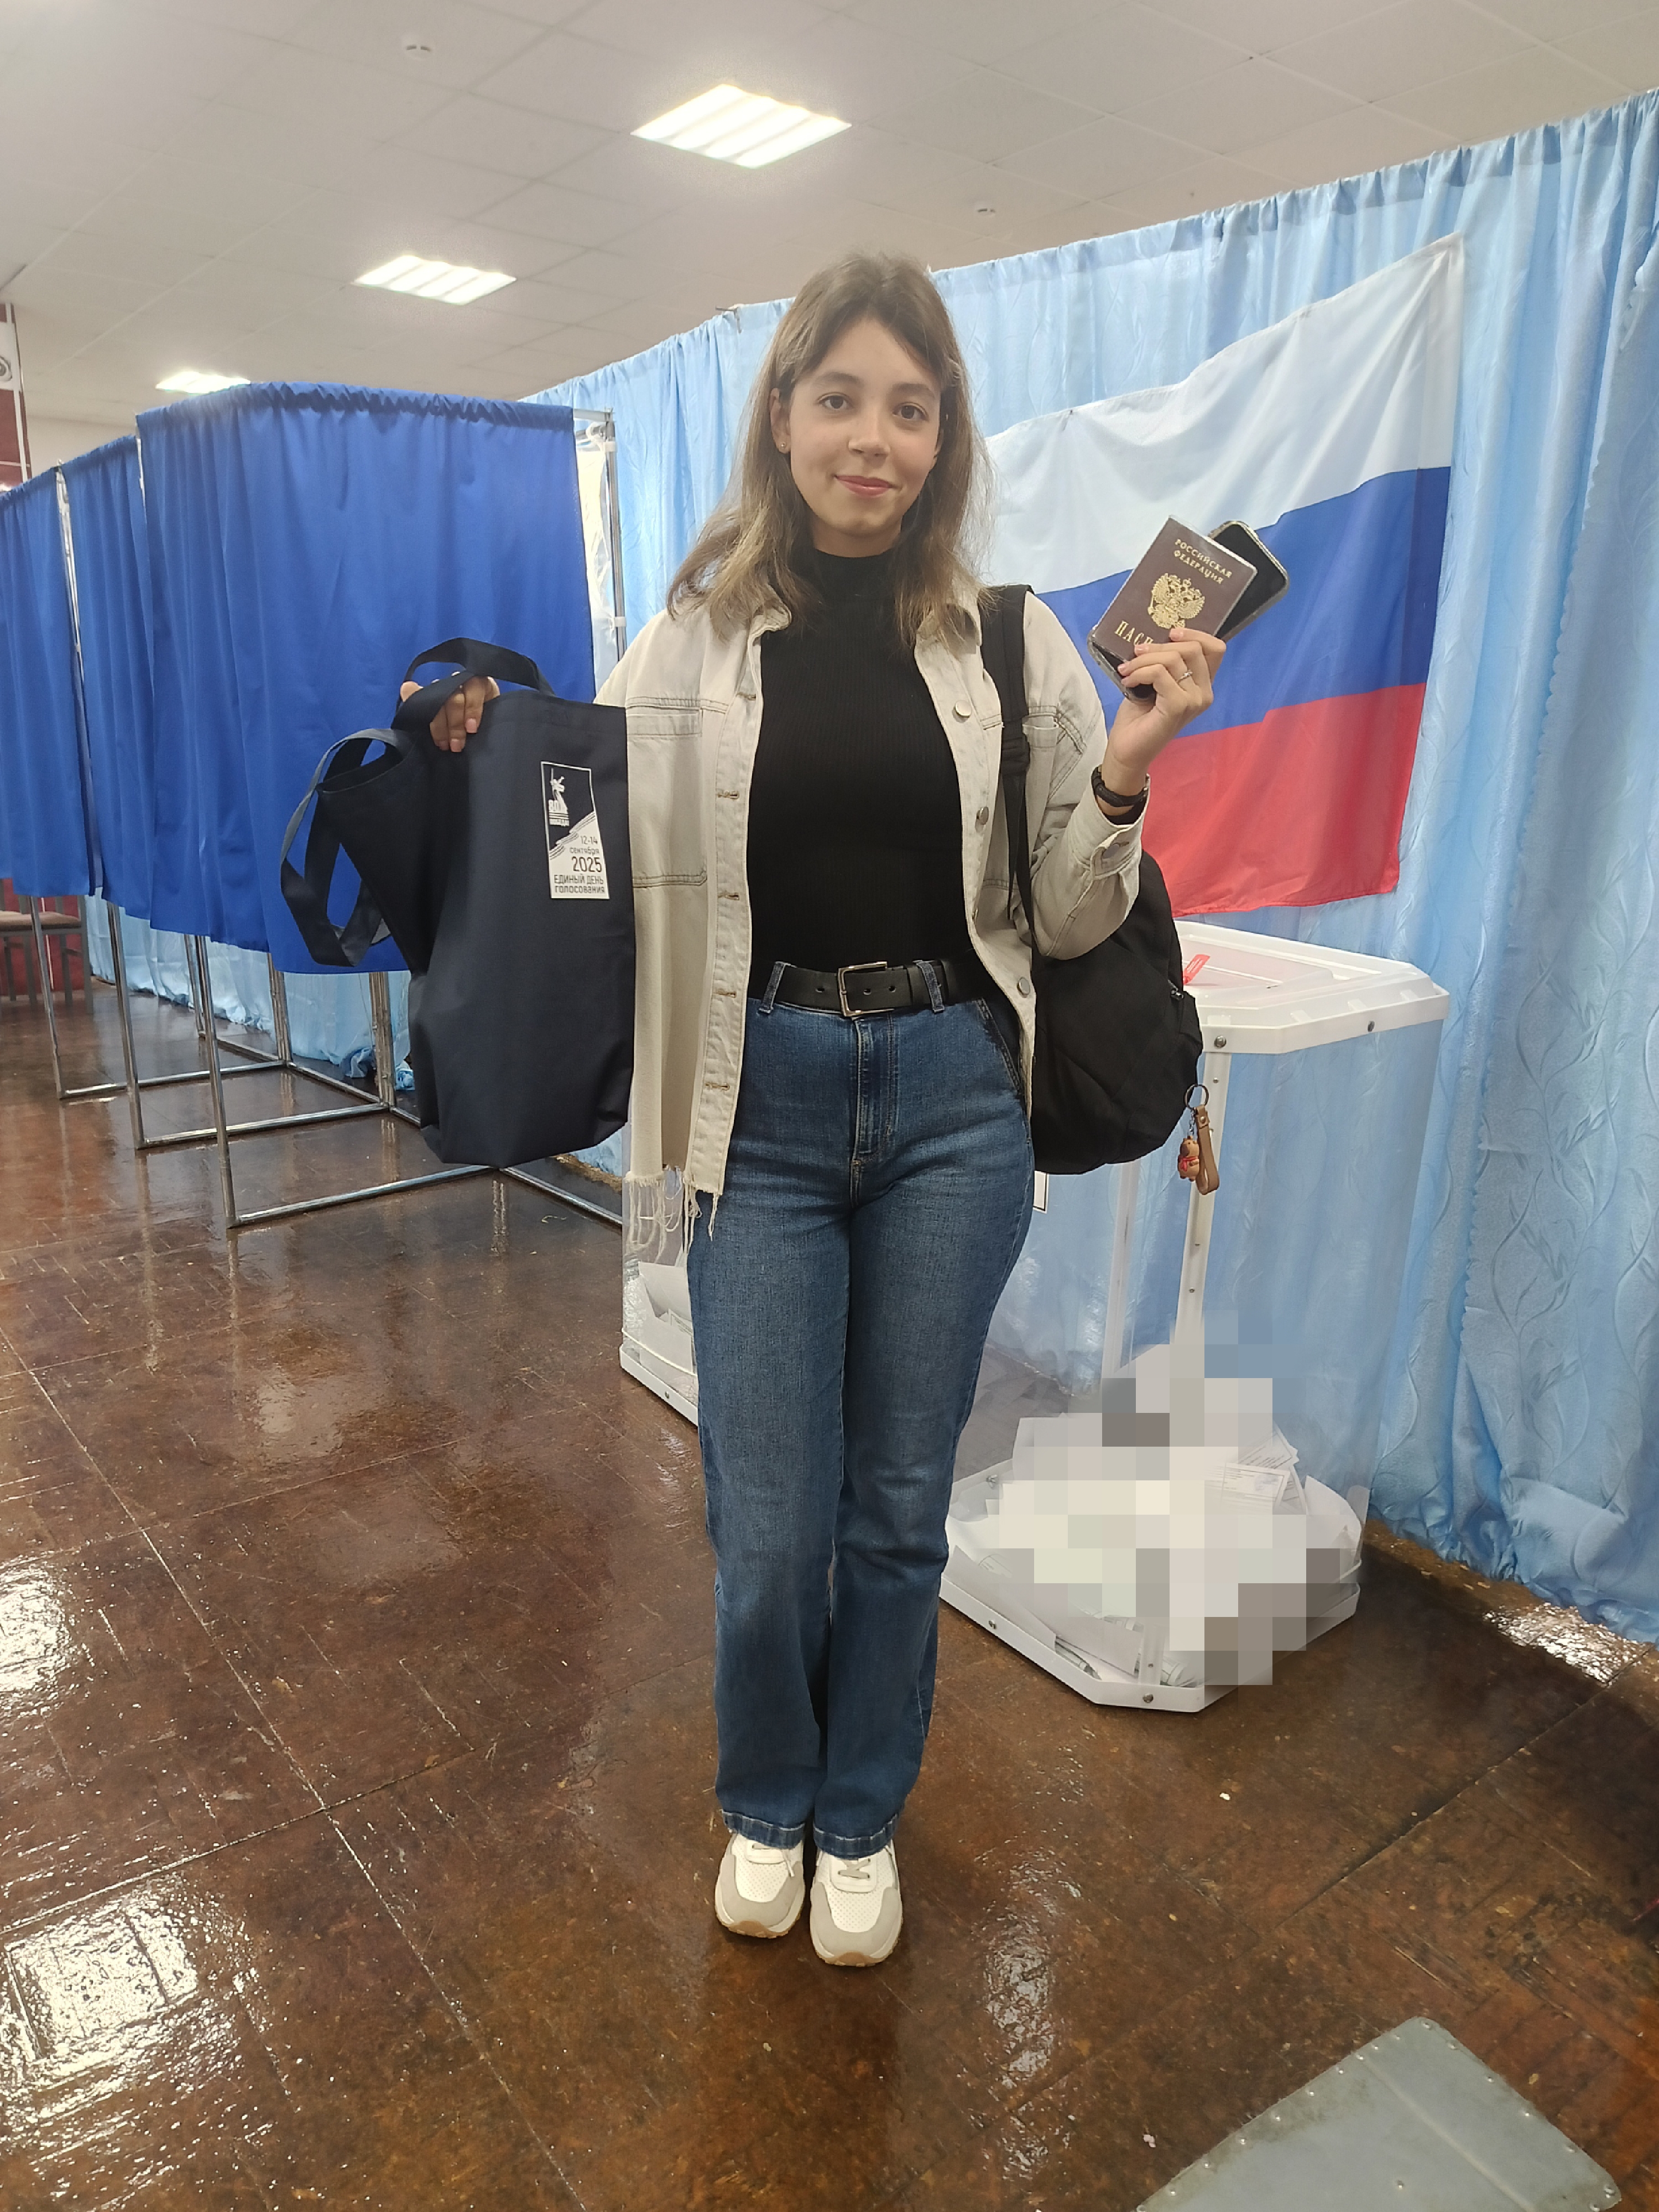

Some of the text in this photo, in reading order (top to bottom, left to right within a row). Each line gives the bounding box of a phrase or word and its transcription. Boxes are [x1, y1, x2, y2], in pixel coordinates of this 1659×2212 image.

[1175, 539, 1232, 578] РОССИЙСКАЯ
[1174, 550, 1224, 584] ФЕДЕРАЦИЯ
[581, 835, 598, 844] 12-14
[570, 846, 599, 855] сентября
[572, 856, 602, 872] 2025
[554, 873, 603, 885] ЕДИНЫЙ ДЕНЬ
